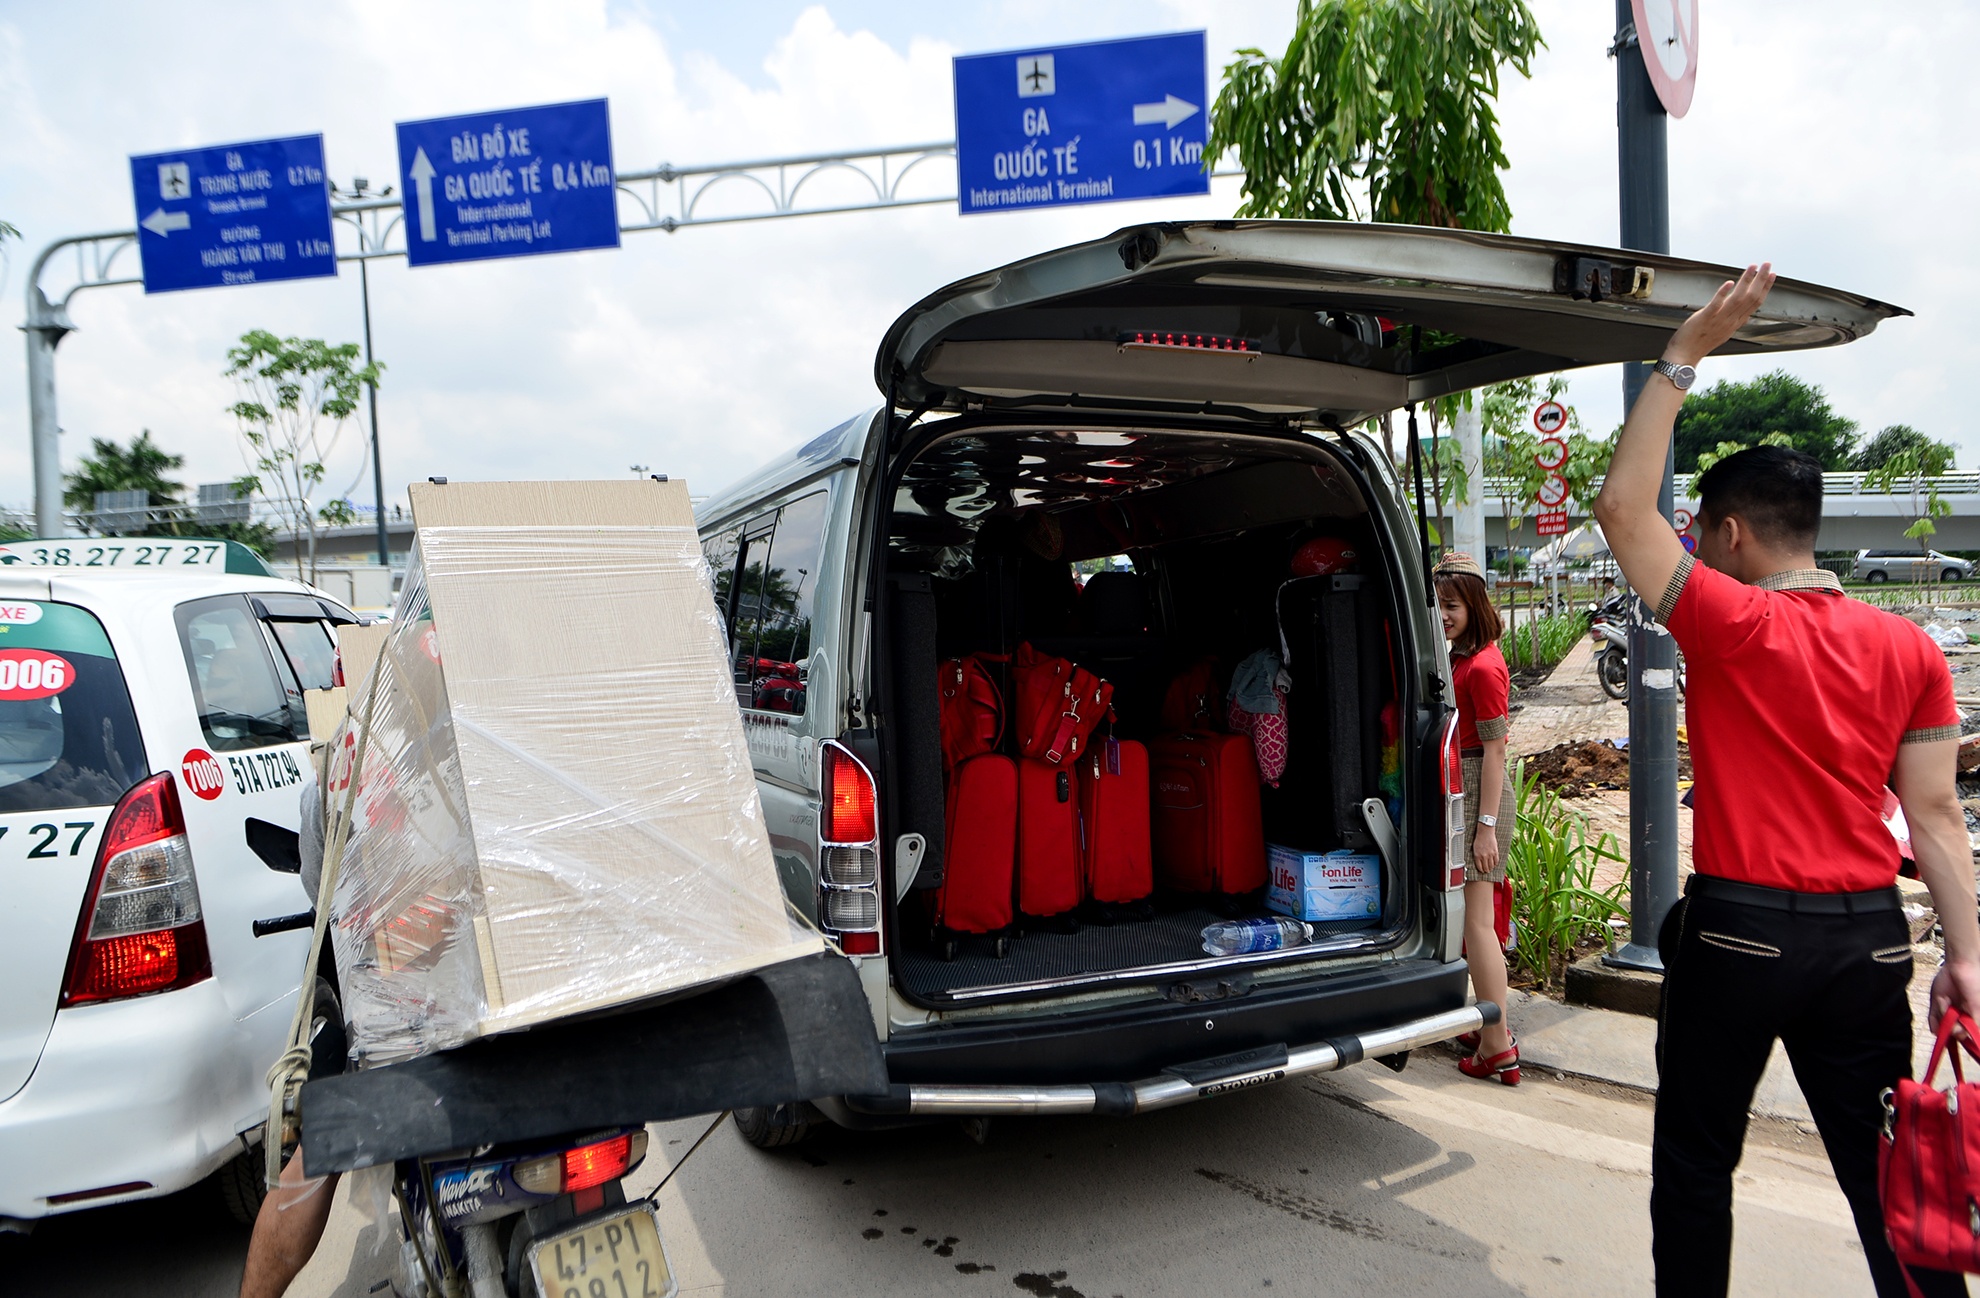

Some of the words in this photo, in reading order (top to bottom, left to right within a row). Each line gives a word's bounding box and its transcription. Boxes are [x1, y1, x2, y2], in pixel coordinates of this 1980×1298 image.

[1023, 107, 1050, 137] GA
[451, 131, 479, 164] BÃI
[481, 123, 505, 160] ĐỖ
[507, 128, 531, 157] XE
[994, 139, 1048, 180] QUỐC
[1053, 135, 1081, 175] TẾ
[1133, 139, 1162, 170] 0,1
[1170, 136, 1203, 165] Km
[225, 151, 245, 171] GA
[552, 161, 579, 191] 0,4
[581, 160, 611, 187] Km
[444, 174, 468, 202] GA
[468, 160, 514, 200] QUỐC
[519, 156, 543, 193] TẾ
[970, 180, 1053, 207] International
[1057, 175, 1113, 199] Terminal
[457, 199, 532, 224] International
[311, 238, 332, 257] Km
[445, 223, 492, 248] Terminal
[492, 219, 533, 244] Parking
[533, 217, 552, 239] Lot
[135, 546, 173, 565] 27
[182, 545, 220, 564] 27
[0, 607, 26, 619] XE
[183, 759, 223, 793] 7006
[228, 756, 265, 795] 51A
[257, 750, 303, 790] 727.94
[27, 822, 95, 859] 27
[1275, 867, 1296, 892] Life
[1343, 866, 1362, 878] Life
[1223, 1072, 1277, 1092] TOYOTA
[564, 1260, 658, 1298] 812
